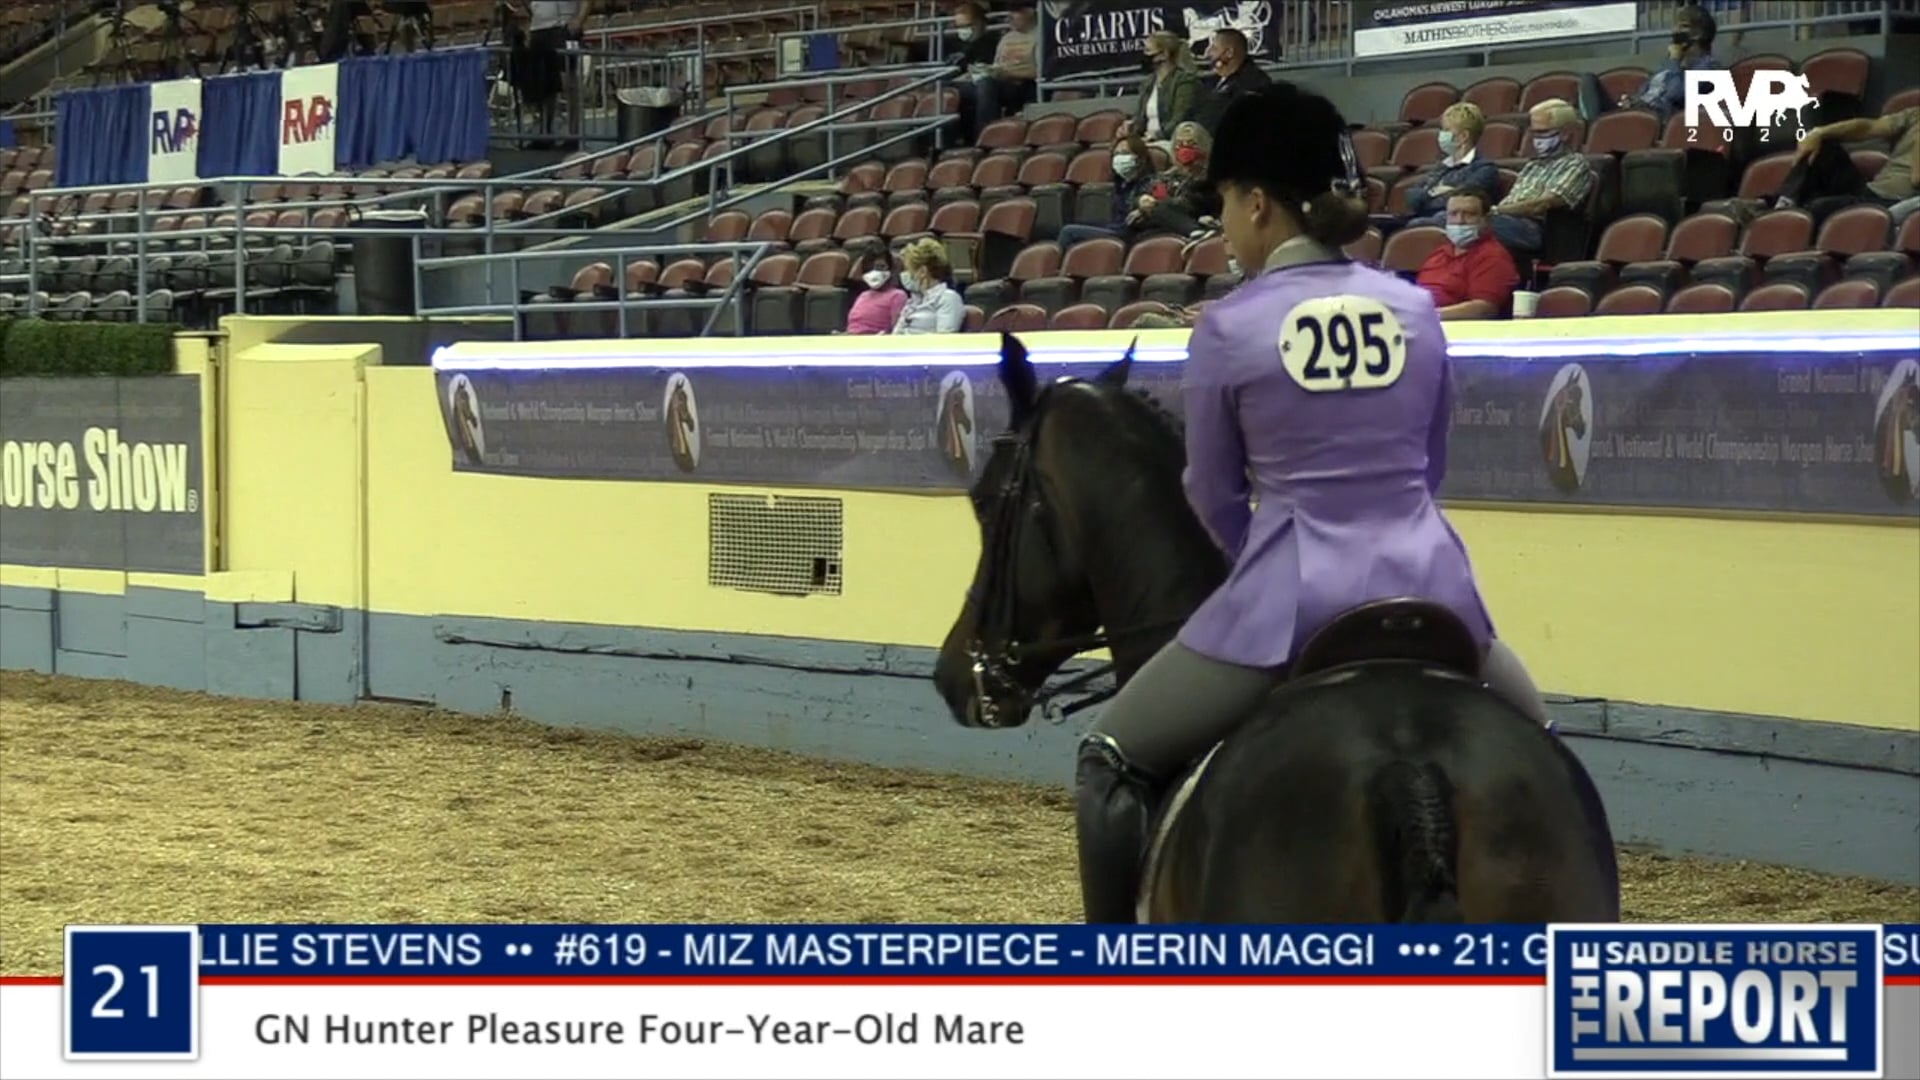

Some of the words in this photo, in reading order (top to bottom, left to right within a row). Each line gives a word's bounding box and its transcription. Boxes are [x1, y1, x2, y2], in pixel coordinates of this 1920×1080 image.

[1055, 18, 1074, 45] C.
[1080, 7, 1165, 42] JARVIS
[1057, 41, 1118, 58] INSURANCE
[1296, 312, 1390, 380] 295
[0, 440, 80, 510] orse
